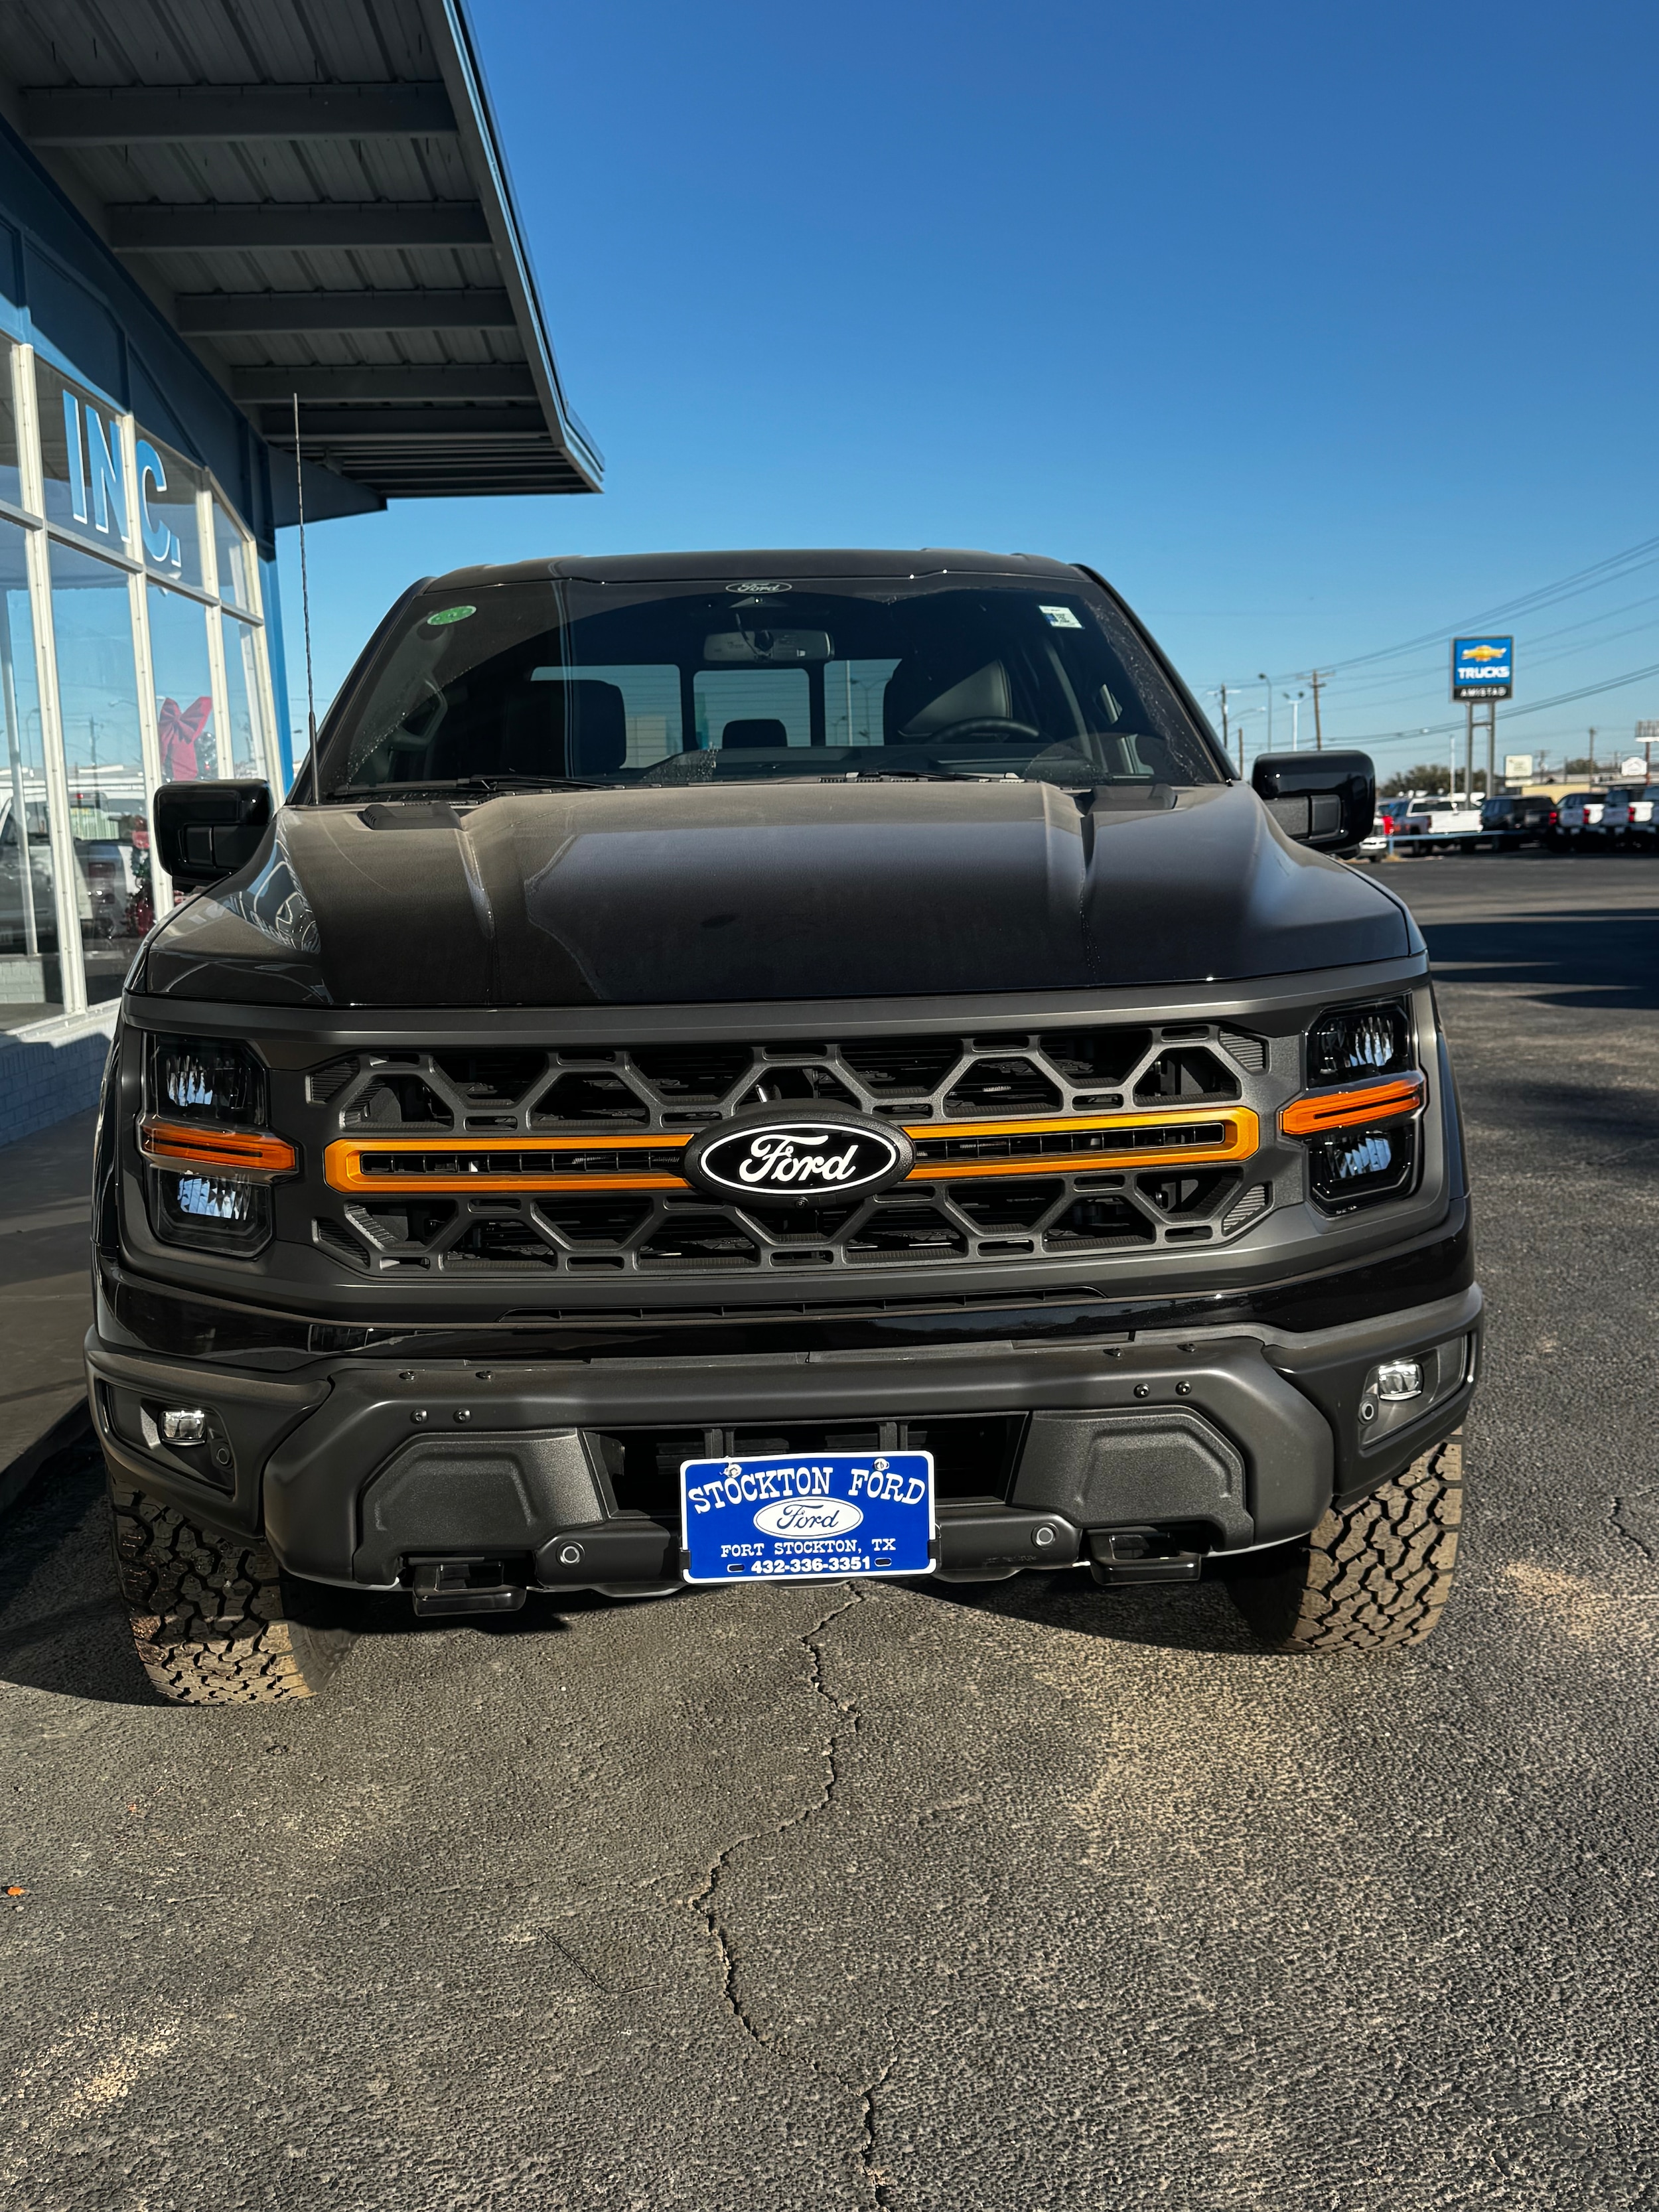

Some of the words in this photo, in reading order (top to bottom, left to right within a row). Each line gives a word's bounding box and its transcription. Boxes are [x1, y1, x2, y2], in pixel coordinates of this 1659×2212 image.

[62, 390, 181, 567] INC.
[737, 583, 781, 592] Ford
[1457, 666, 1510, 679] TRUCKS
[739, 1134, 859, 1183] Ford
[688, 1467, 833, 1514] STOCKTON
[847, 1469, 926, 1505] FORD
[776, 1504, 839, 1530] Ford
[721, 1543, 764, 1558] FORT
[774, 1539, 862, 1555] STOCKTON,
[871, 1538, 897, 1552] TX
[751, 1556, 871, 1574] 432-336-3351
